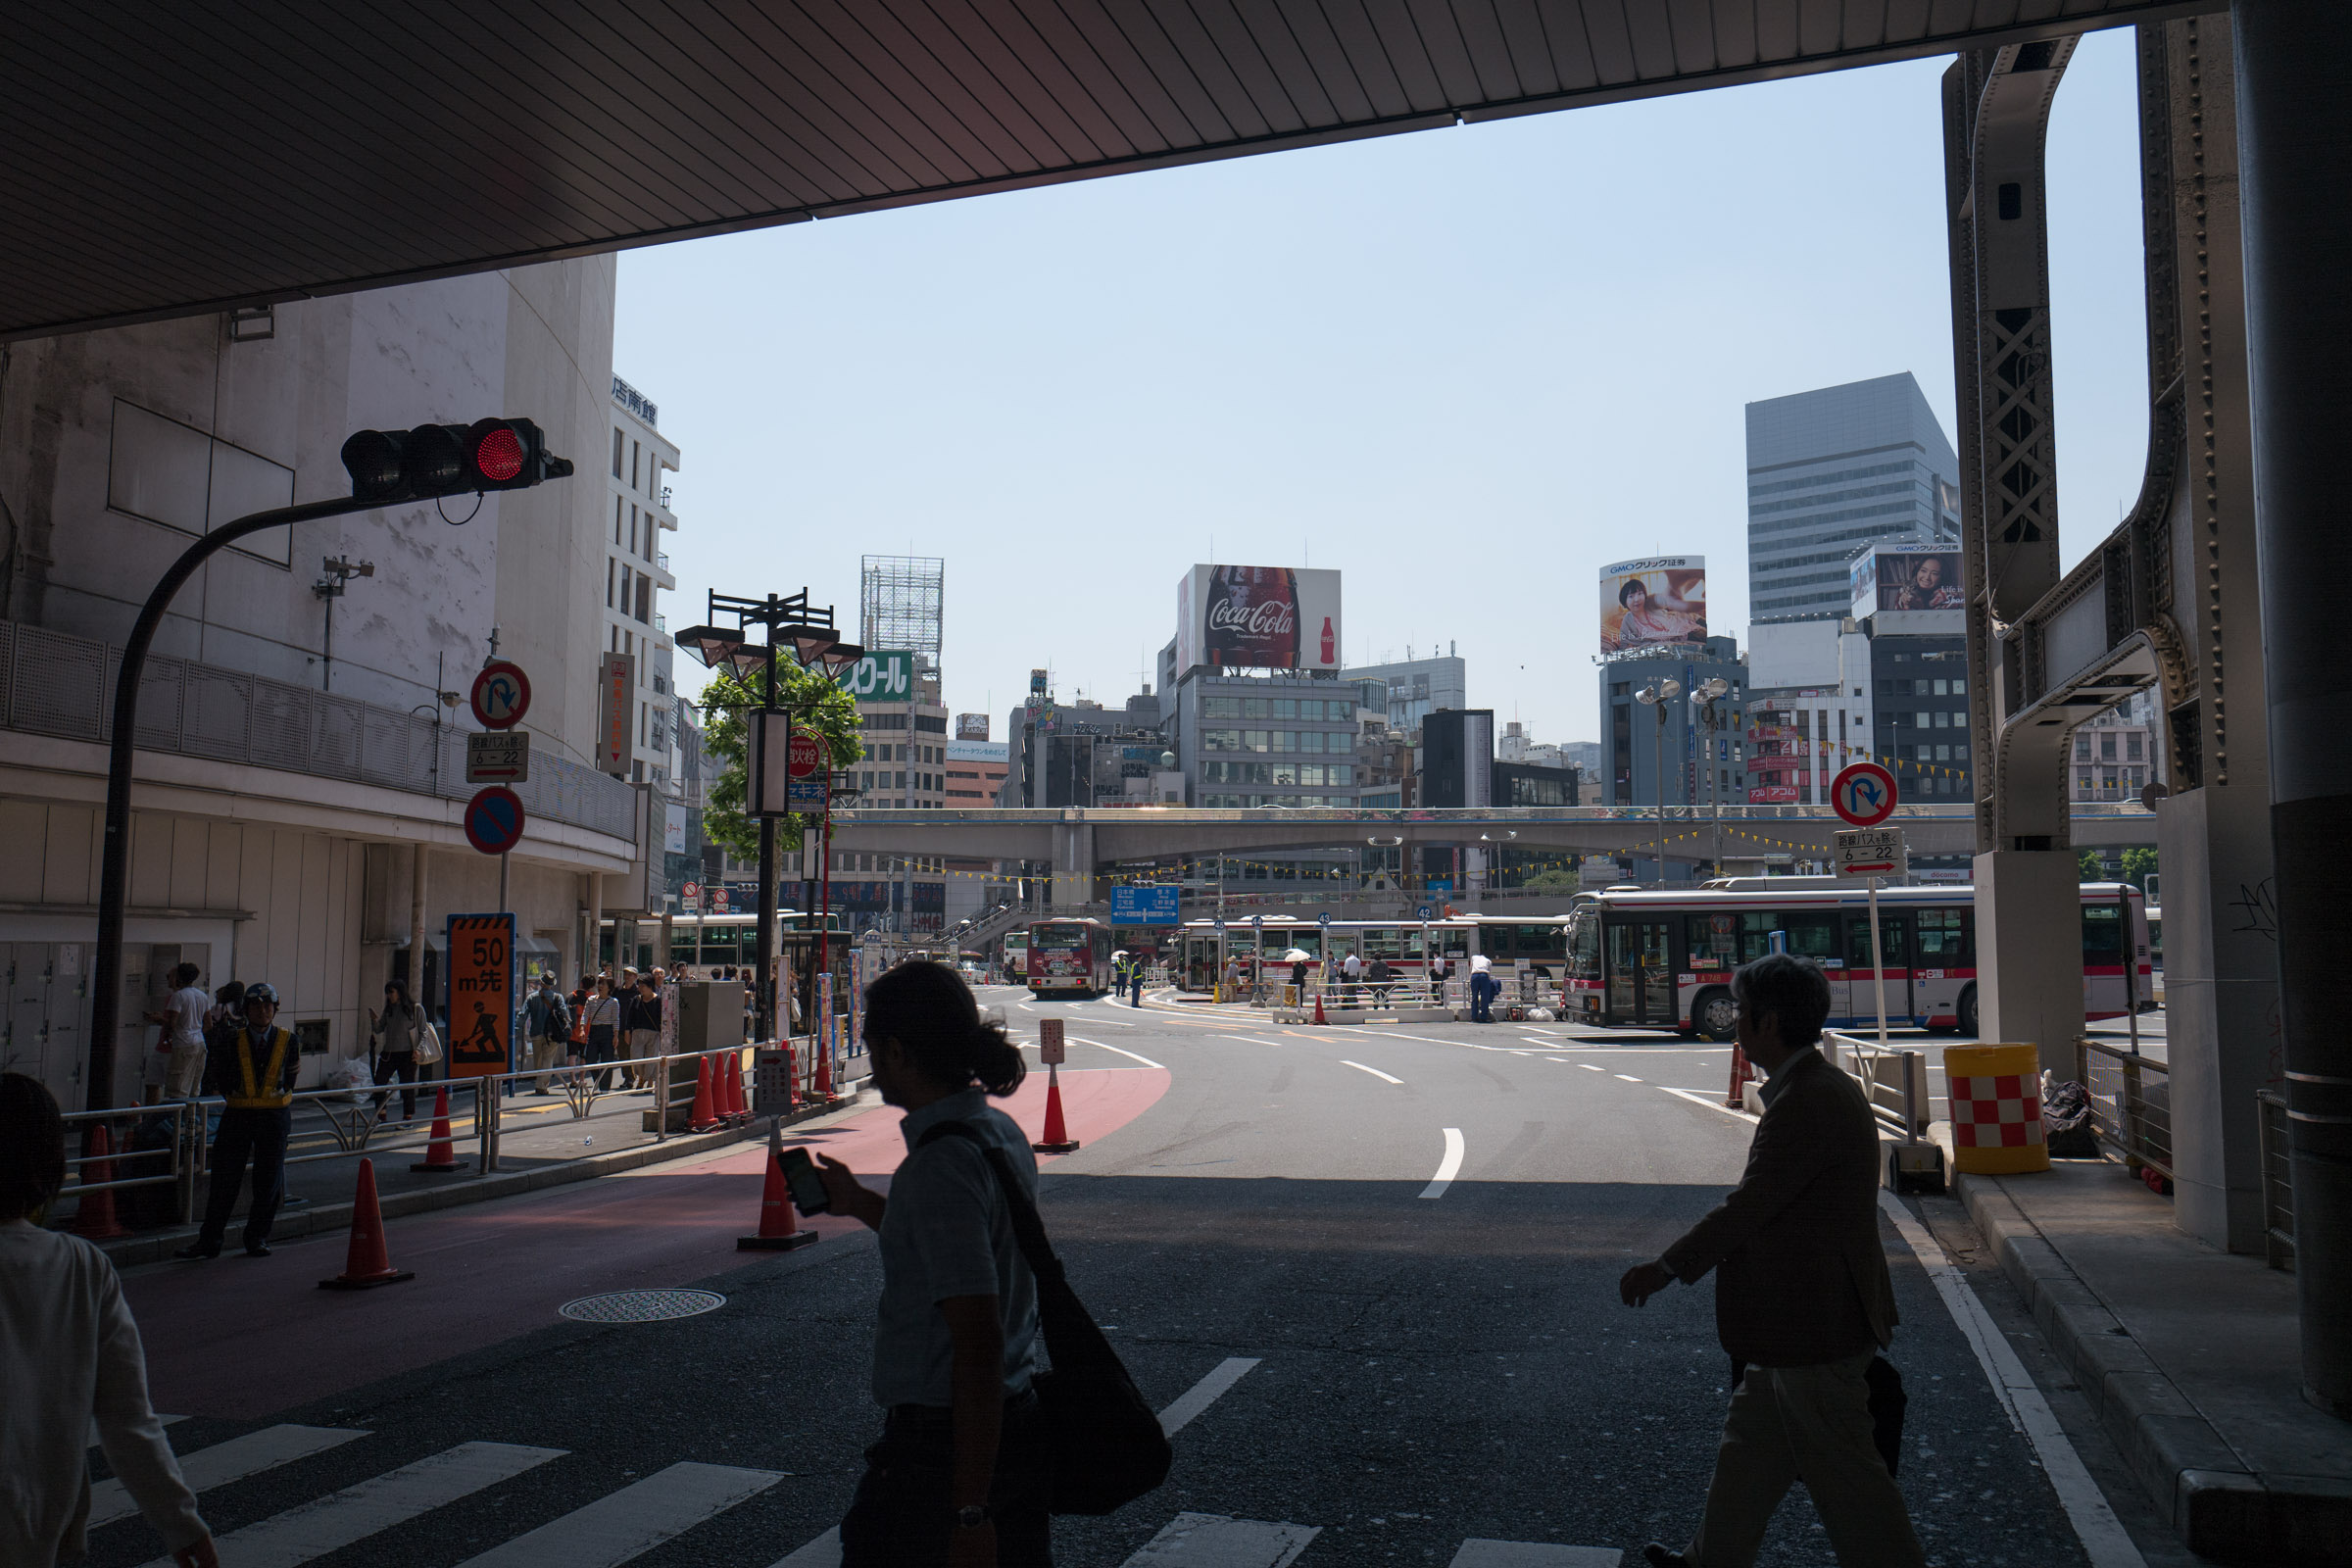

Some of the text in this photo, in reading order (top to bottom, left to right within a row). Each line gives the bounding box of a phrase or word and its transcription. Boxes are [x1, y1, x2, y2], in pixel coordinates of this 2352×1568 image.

[1610, 559, 1686, 574] GMOクリック証券
[472, 736, 525, 749] 路線バスを除く
[476, 752, 484, 763] 6
[503, 751, 518, 763] 22
[1771, 787, 1796, 796] アコム
[1838, 832, 1896, 846] 路線バスを除く
[1845, 849, 1853, 860] 6
[1876, 847, 1893, 858] 22
[1318, 914, 1330, 923] 43
[1418, 908, 1431, 918] 42
[1252, 917, 1263, 926] 44
[473, 938, 504, 967] 50
[459, 969, 503, 992] m先
[1832, 986, 1849, 996] Bus
